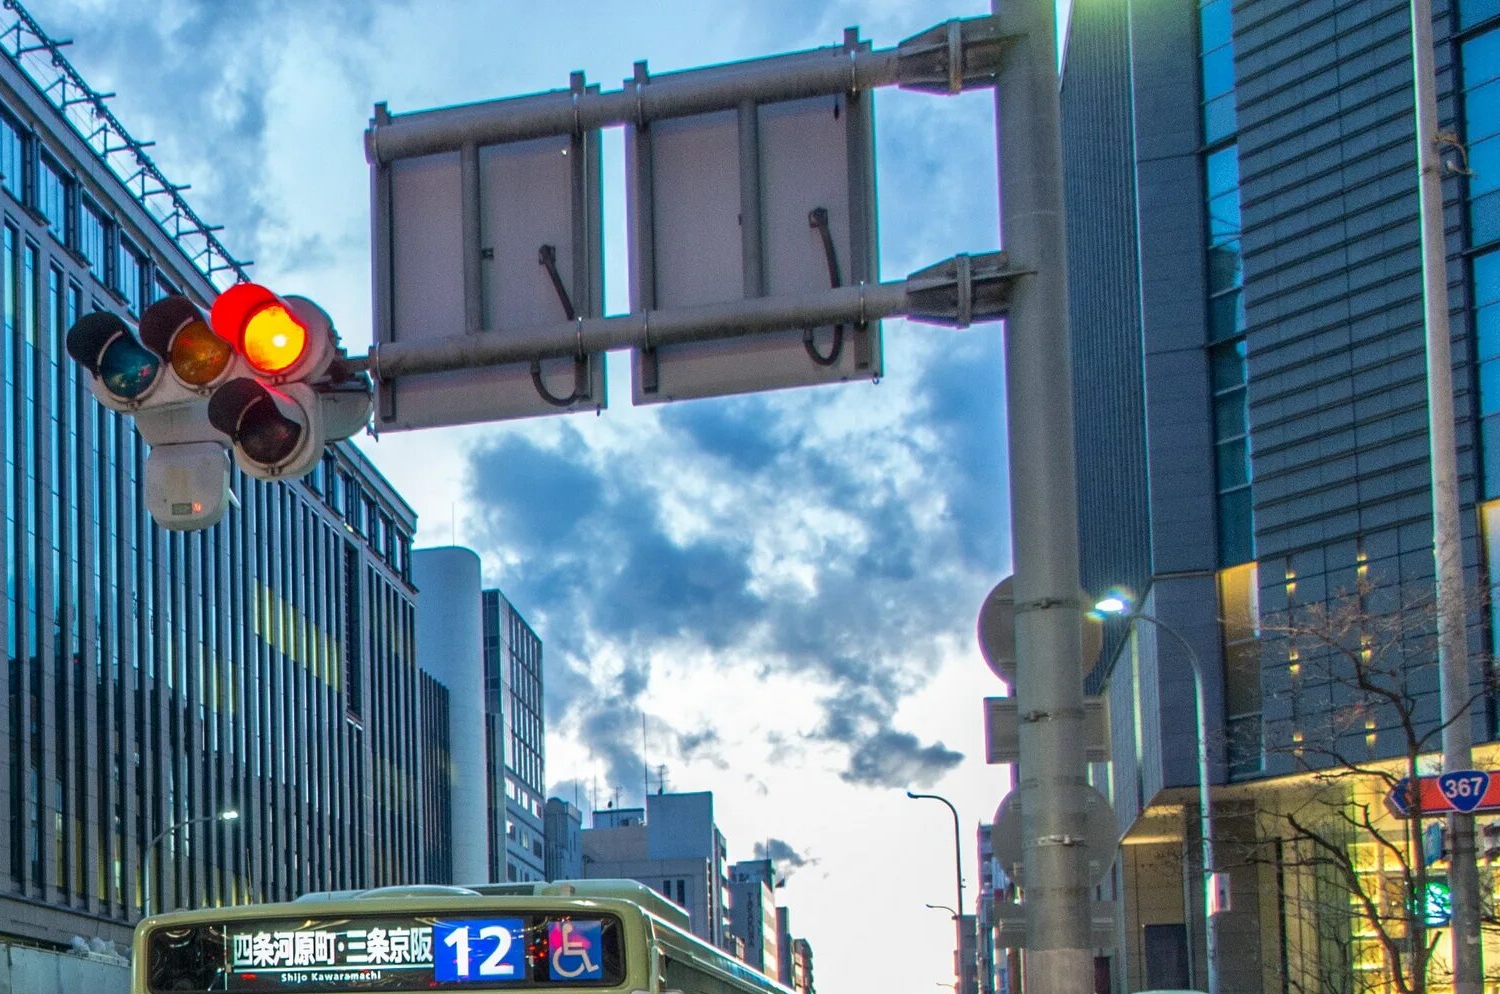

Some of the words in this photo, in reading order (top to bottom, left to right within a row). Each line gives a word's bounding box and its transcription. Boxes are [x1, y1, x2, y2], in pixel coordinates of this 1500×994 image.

[1445, 776, 1483, 799] 367
[233, 927, 434, 967] 四条河原町・三条京阪
[444, 925, 514, 977] 12
[281, 972, 308, 984] Shijo
[311, 970, 381, 982] Kawaramachi
